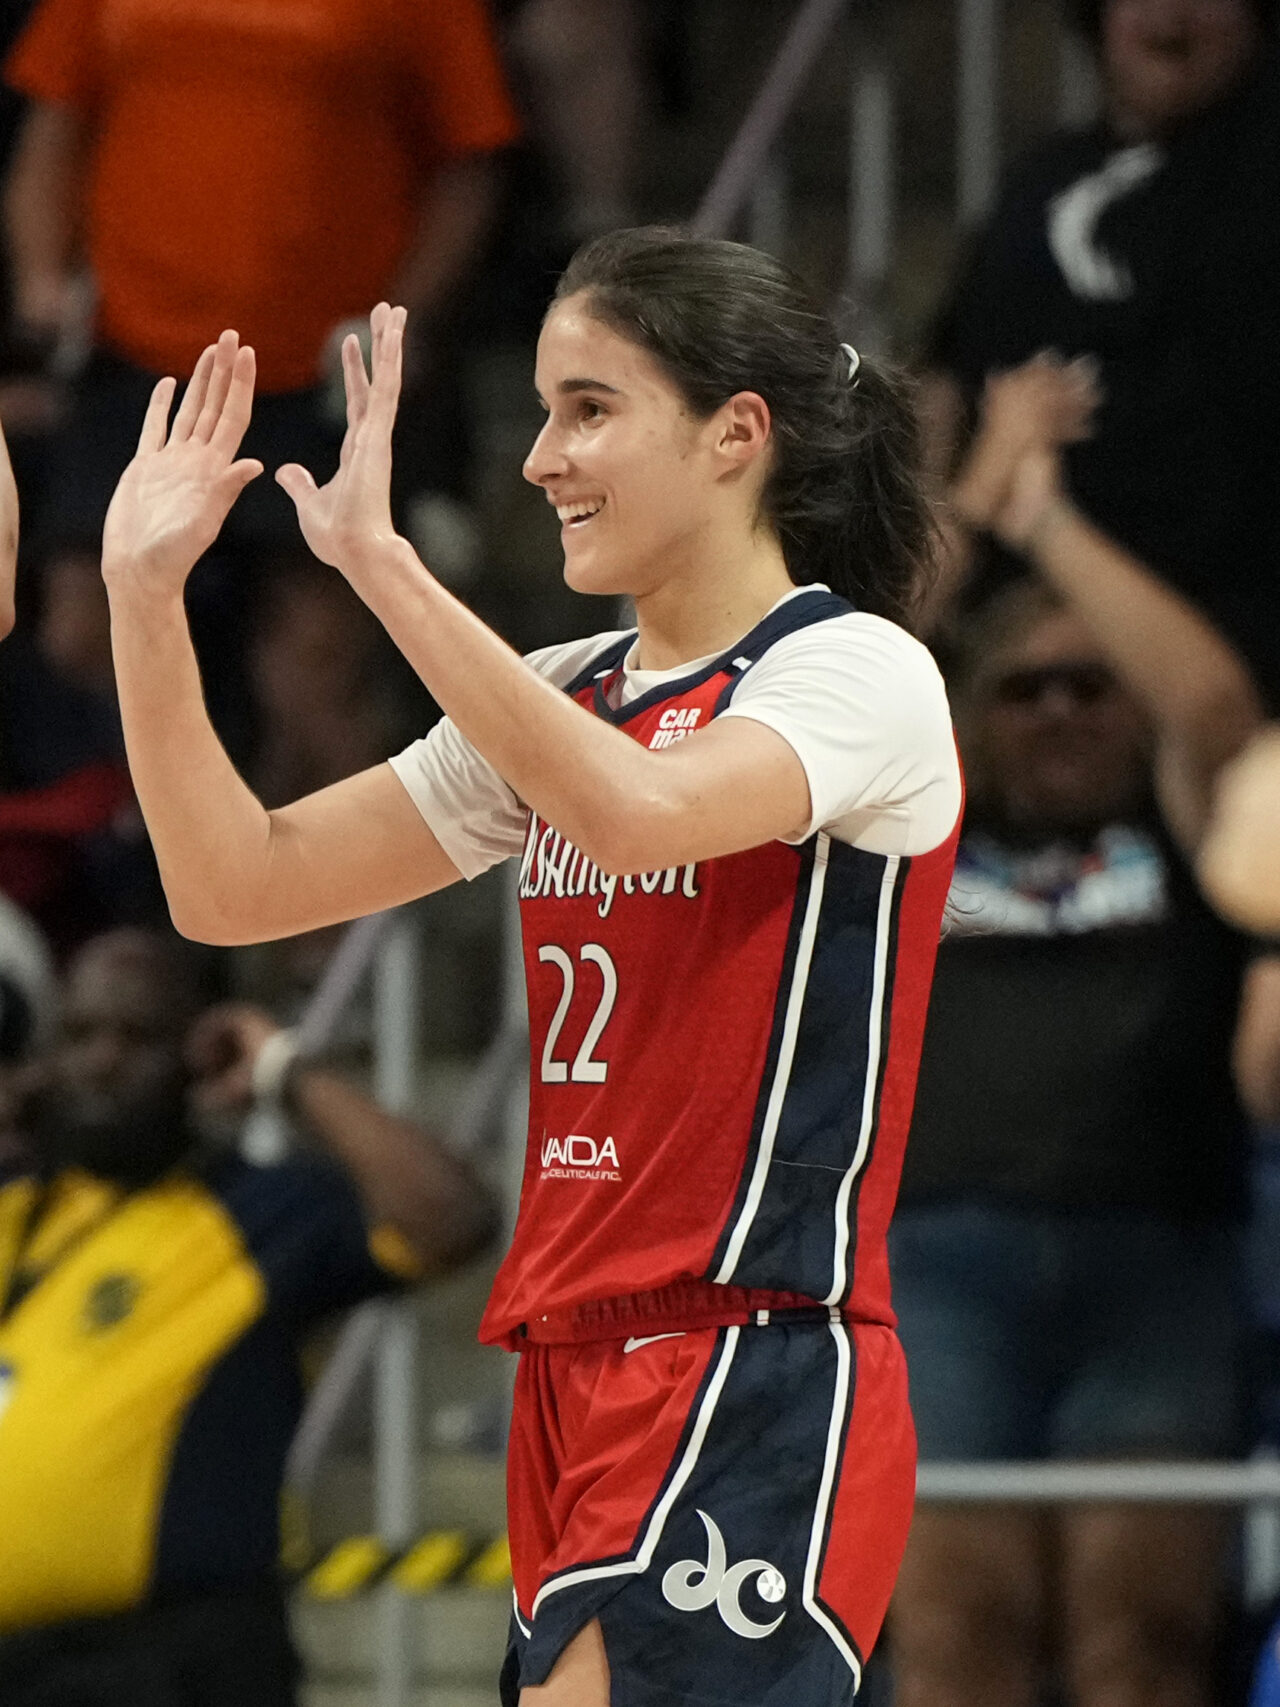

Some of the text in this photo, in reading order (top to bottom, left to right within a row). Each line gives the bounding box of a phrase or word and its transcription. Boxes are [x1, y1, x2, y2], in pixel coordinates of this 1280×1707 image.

[658, 707, 702, 730] CAR
[648, 728, 696, 750] ma
[538, 942, 618, 1083] 22
